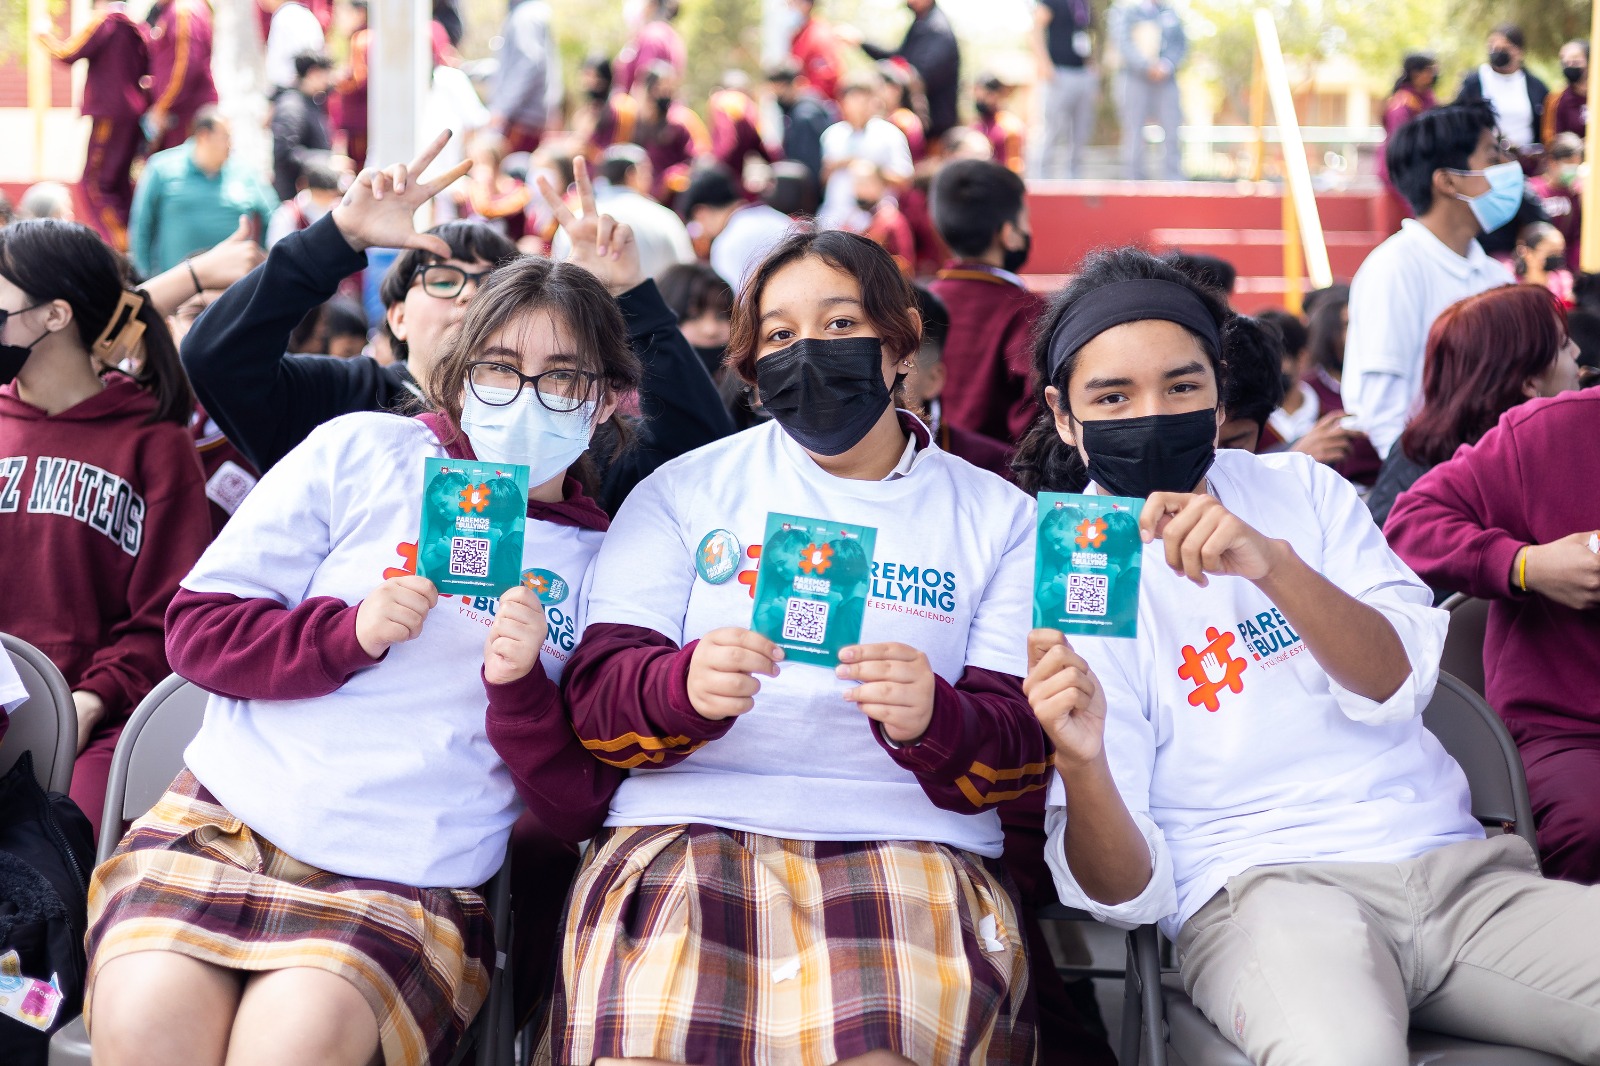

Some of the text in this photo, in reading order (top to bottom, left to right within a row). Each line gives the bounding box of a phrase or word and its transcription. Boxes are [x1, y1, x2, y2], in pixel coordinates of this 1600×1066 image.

[27, 455, 146, 557] MATEOS
[456, 516, 490, 525] PAREMOS
[1072, 552, 1108, 561] PAREMOS
[793, 575, 831, 588] PAREMOS
[870, 561, 956, 592] REMOS
[869, 578, 956, 613] LLYING
[875, 600, 903, 613] ESTÁS
[905, 606, 955, 625] HACIENDO?
[1236, 607, 1287, 643] PARE
[459, 606, 465, 614] Y
[540, 643, 568, 664] CIENDO?
[1252, 625, 1301, 658] BULL
[1289, 643, 1306, 657] EST
